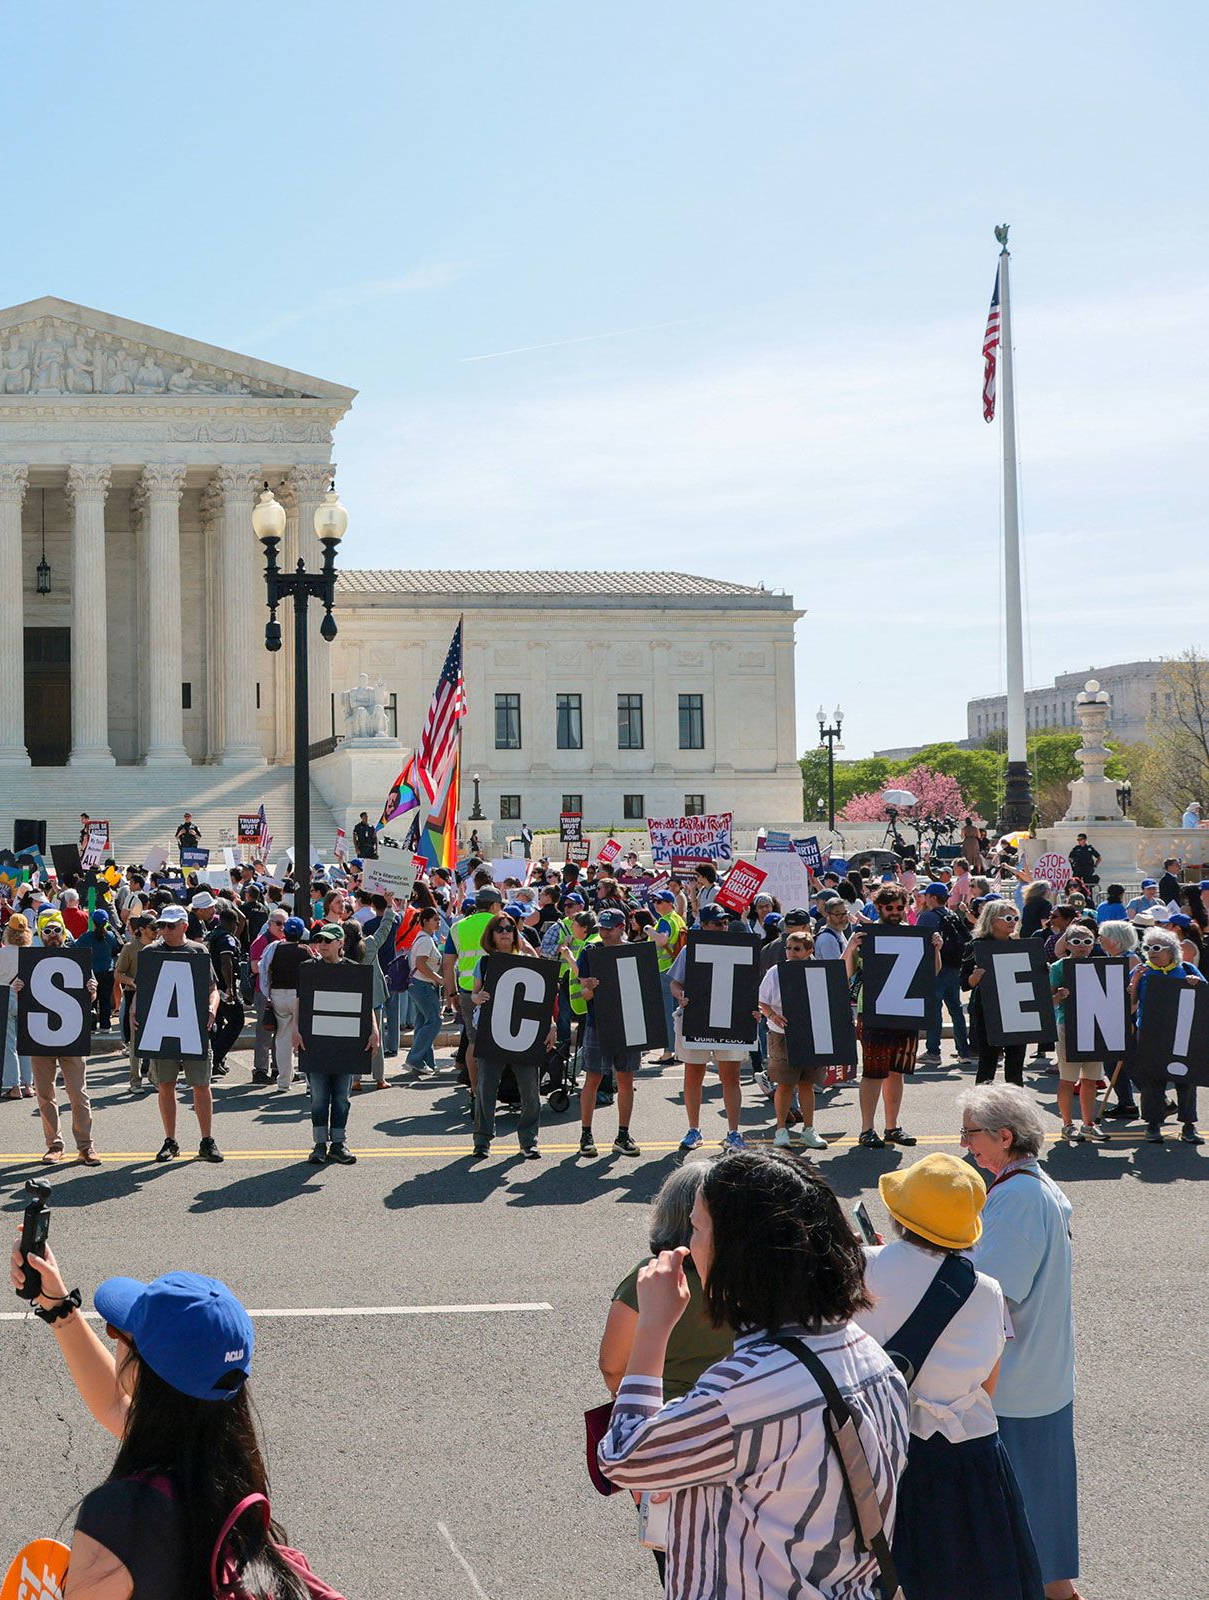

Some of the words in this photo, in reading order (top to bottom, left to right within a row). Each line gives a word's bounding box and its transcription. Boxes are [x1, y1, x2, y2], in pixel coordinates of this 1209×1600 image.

[83, 855, 97, 866] ALL
[1039, 854, 1066, 867] STOP
[383, 872, 402, 880] literally
[1034, 868, 1070, 879] RACISM
[731, 870, 759, 891] BIRTH
[726, 880, 754, 900] RIGHT
[224, 1349, 244, 1363] ACLU
